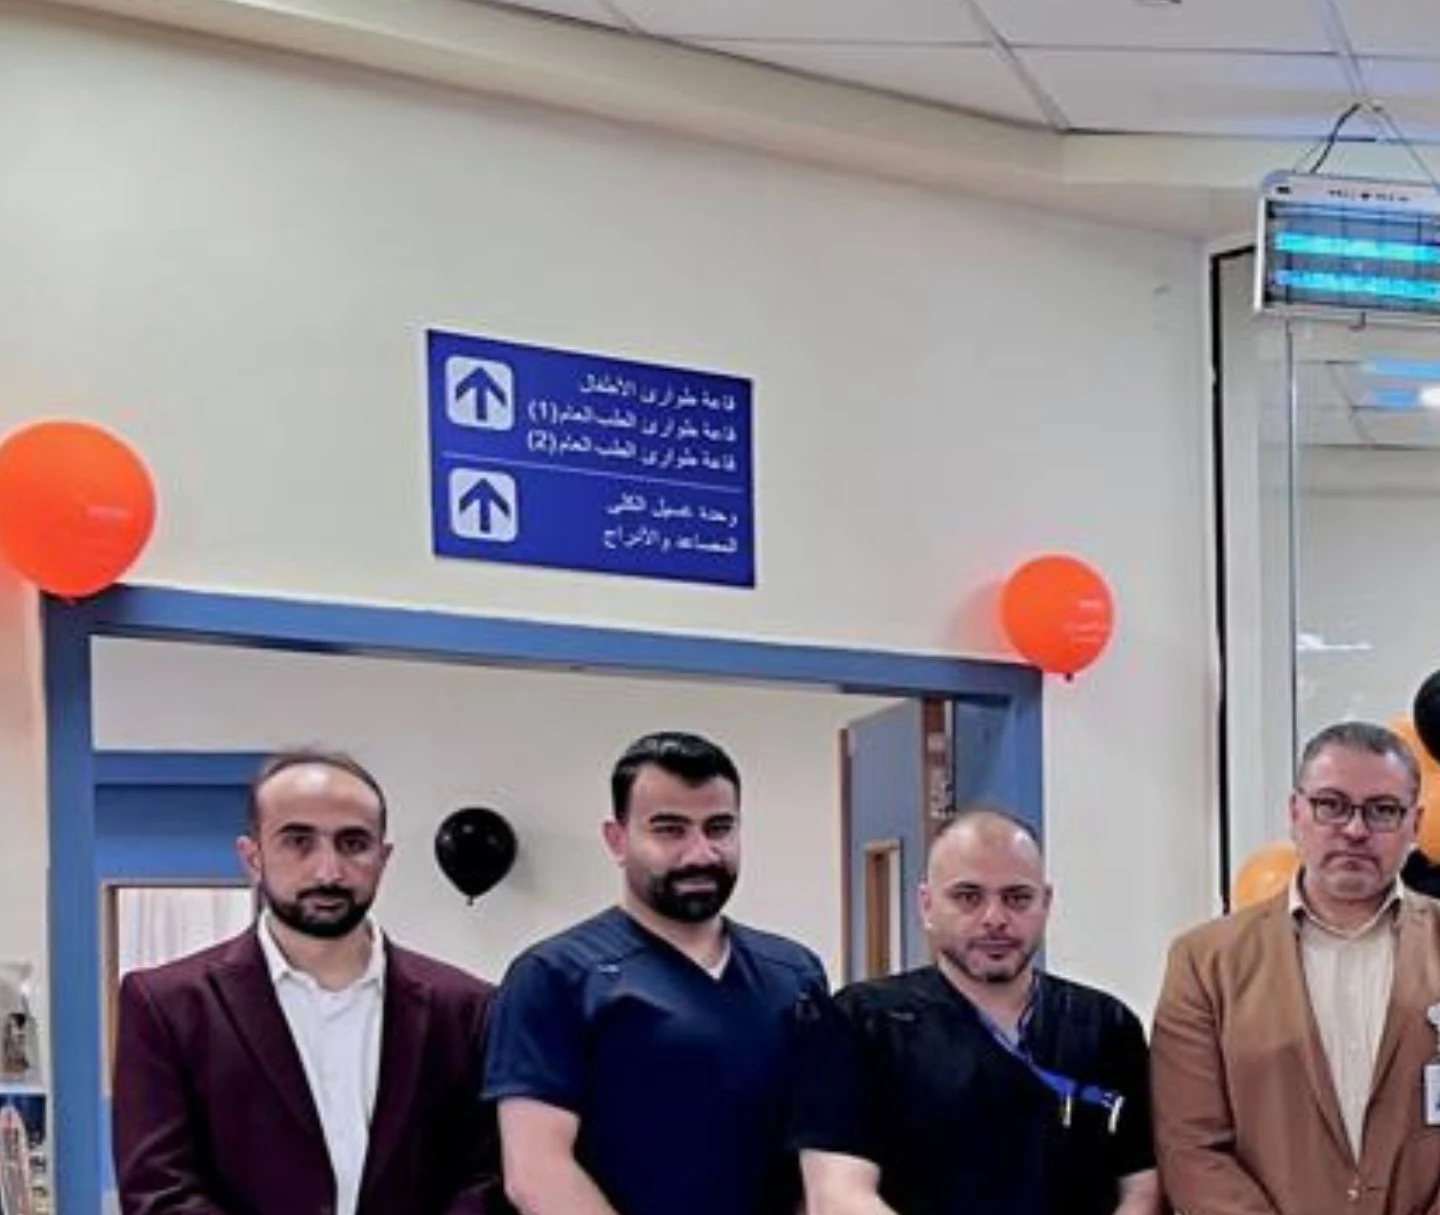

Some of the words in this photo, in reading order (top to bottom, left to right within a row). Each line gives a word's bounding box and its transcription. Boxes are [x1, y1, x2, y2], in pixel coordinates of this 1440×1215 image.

[701, 389, 736, 411] قاعة
[596, 408, 638, 429] الطب
[701, 419, 737, 443] قاعة
[595, 438, 638, 459] الطب
[701, 449, 737, 472] قاعة
[675, 532, 738, 553] المصاعد
